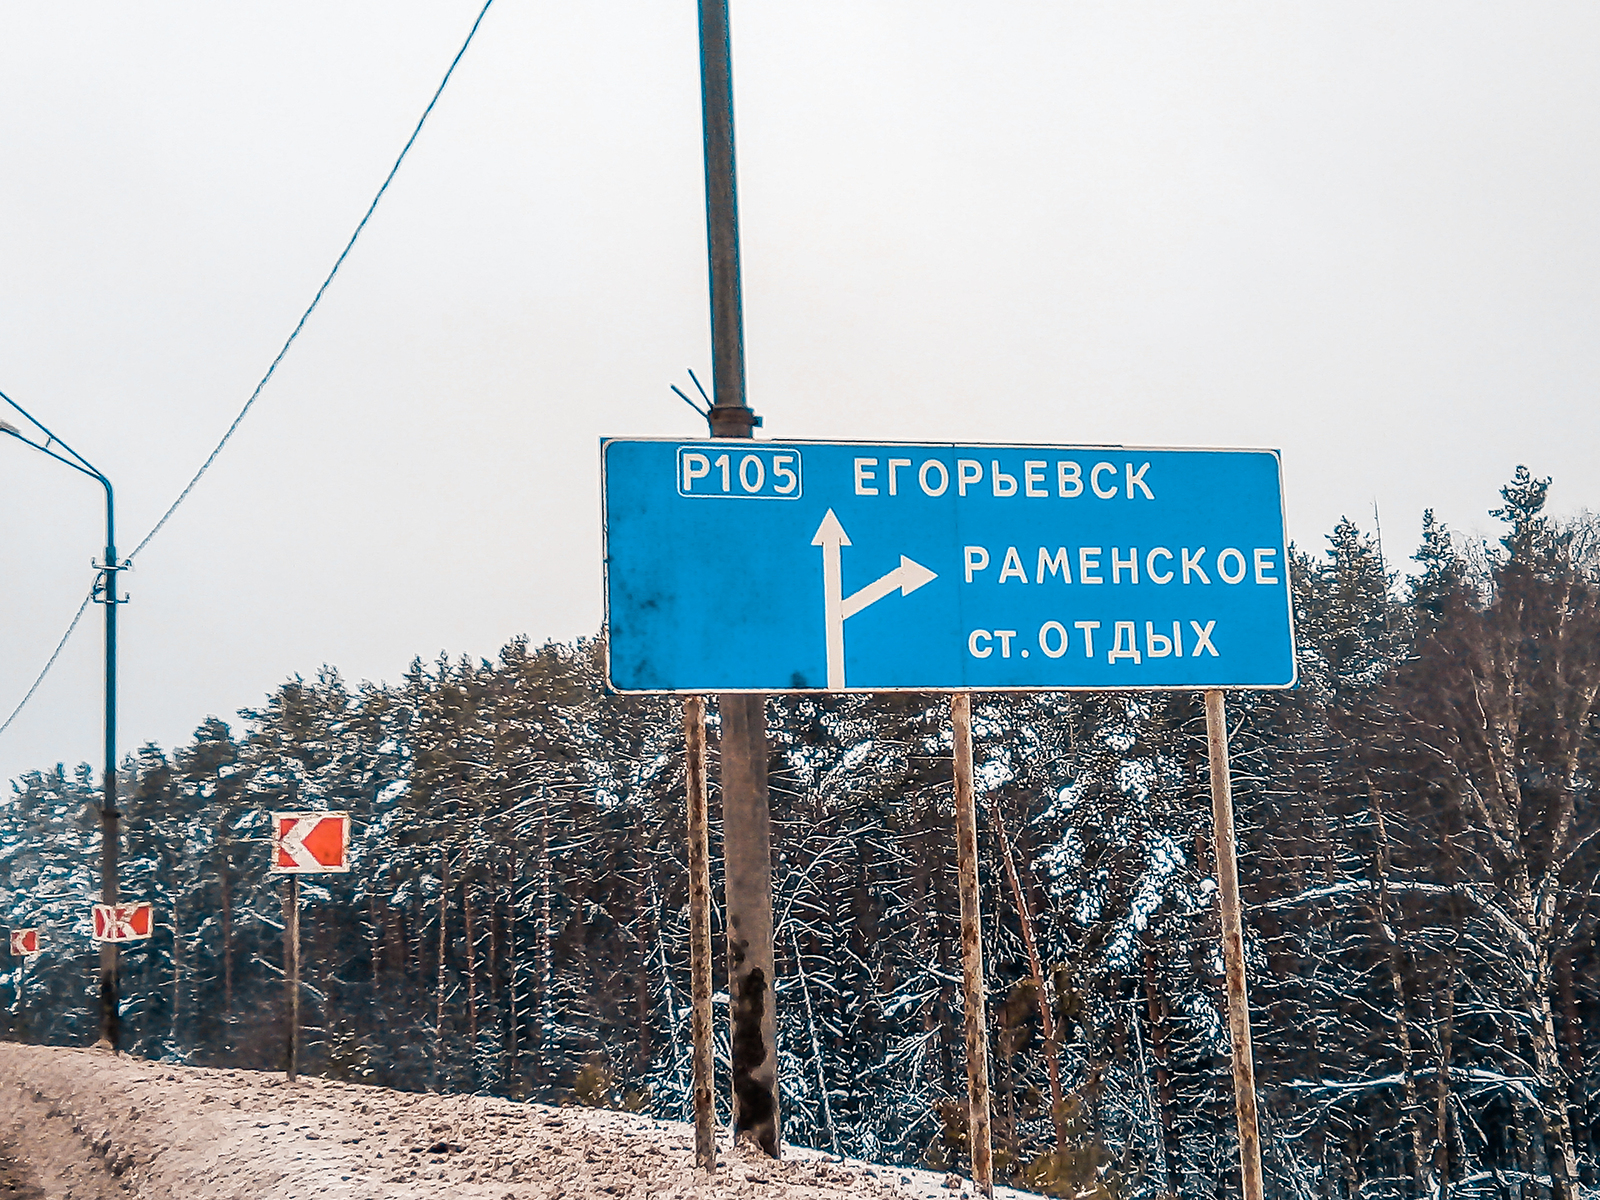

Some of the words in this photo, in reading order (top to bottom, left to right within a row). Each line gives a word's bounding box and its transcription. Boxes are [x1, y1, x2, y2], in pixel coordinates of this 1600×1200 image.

[683, 453, 798, 495] Р105
[854, 457, 1156, 500] ЕГОРЬЕВСК
[964, 545, 1279, 585] РАМЕНСКОЕ
